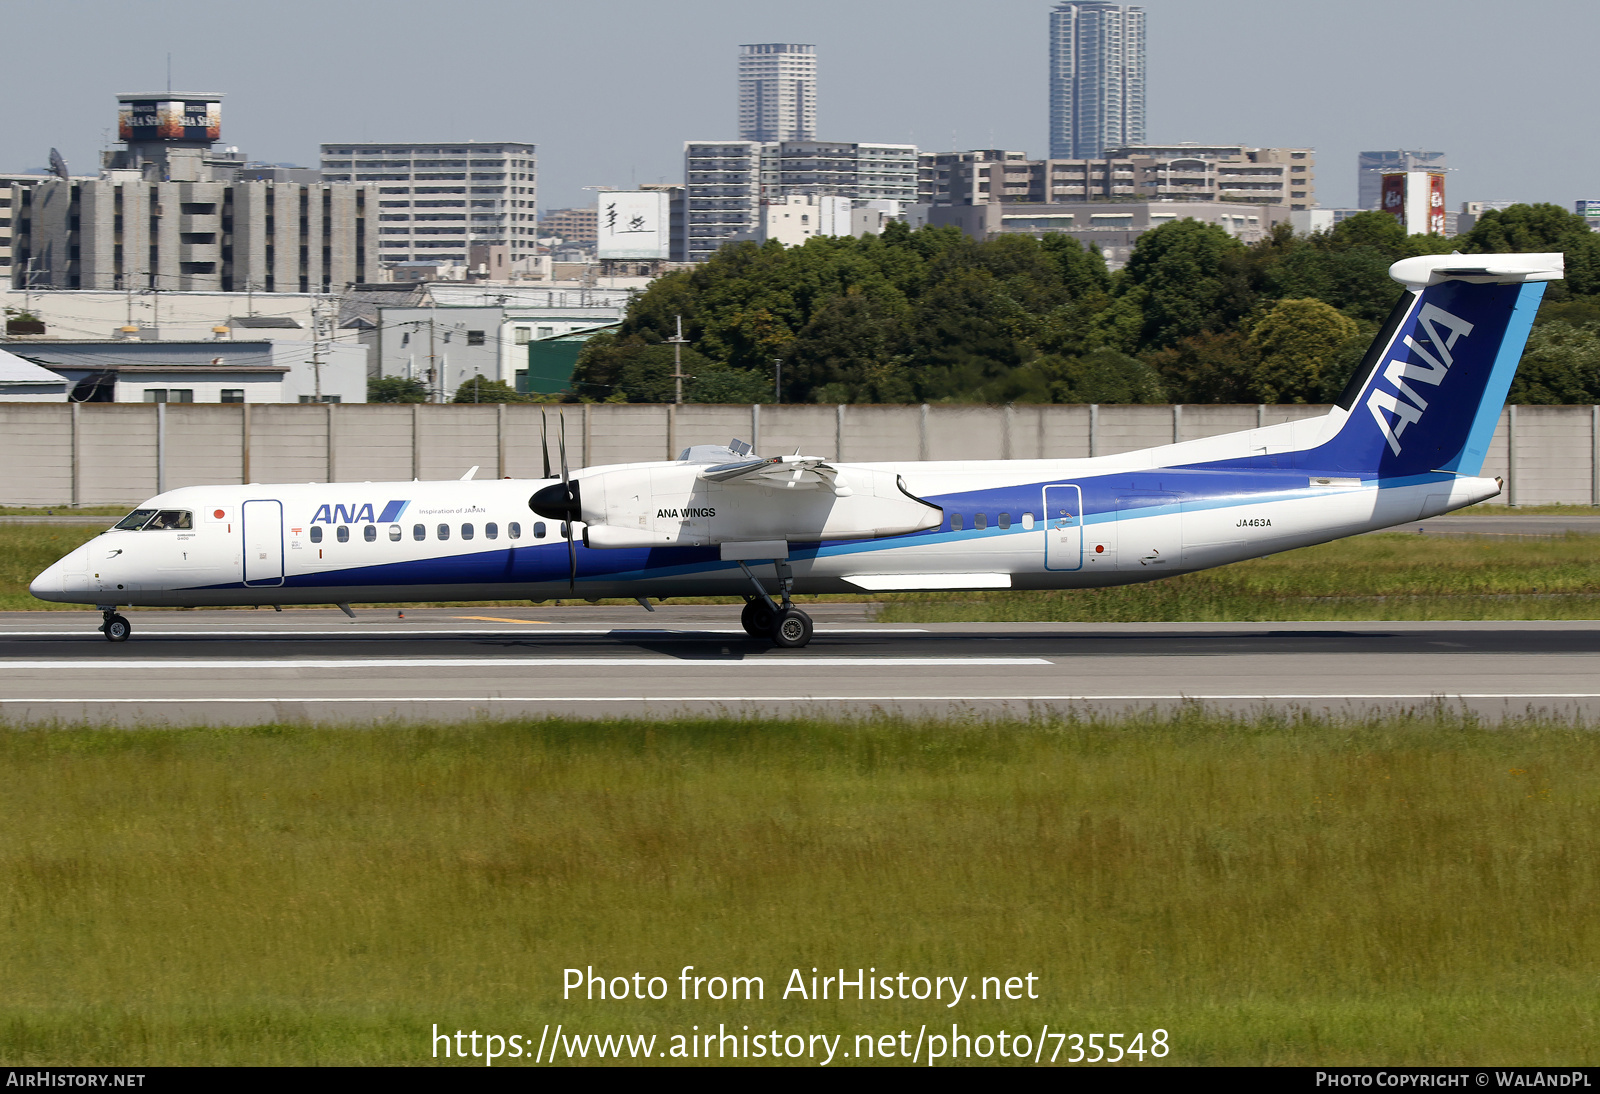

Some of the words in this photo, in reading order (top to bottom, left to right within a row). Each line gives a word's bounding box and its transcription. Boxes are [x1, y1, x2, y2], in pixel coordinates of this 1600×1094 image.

[1366, 302, 1475, 457] ANA
[310, 503, 375, 524] ANA
[656, 508, 679, 519] ANA
[680, 507, 716, 518] WINGS
[1236, 518, 1272, 528] JA463A
